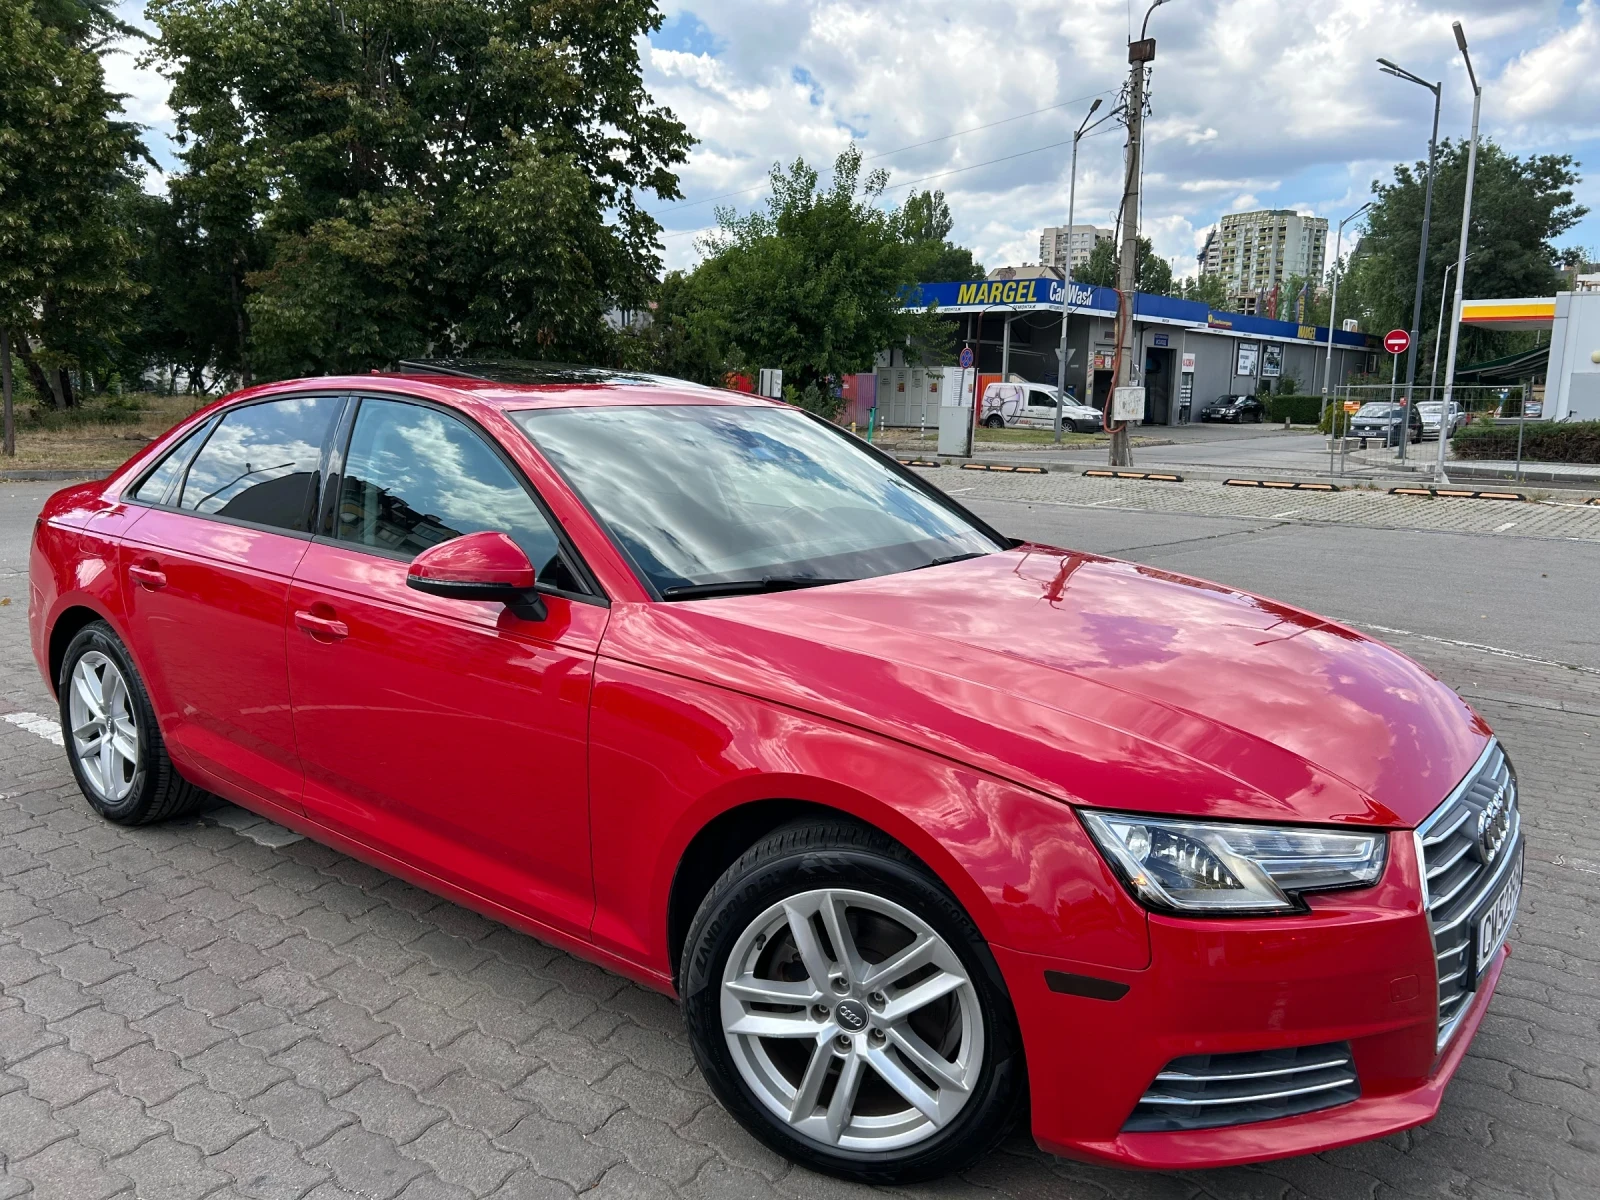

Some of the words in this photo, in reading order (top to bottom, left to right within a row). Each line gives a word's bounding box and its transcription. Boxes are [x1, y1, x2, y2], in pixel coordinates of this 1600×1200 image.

[957, 281, 1037, 304] MARGEL
[1049, 281, 1065, 302] Car
[1067, 285, 1093, 306] Wash
